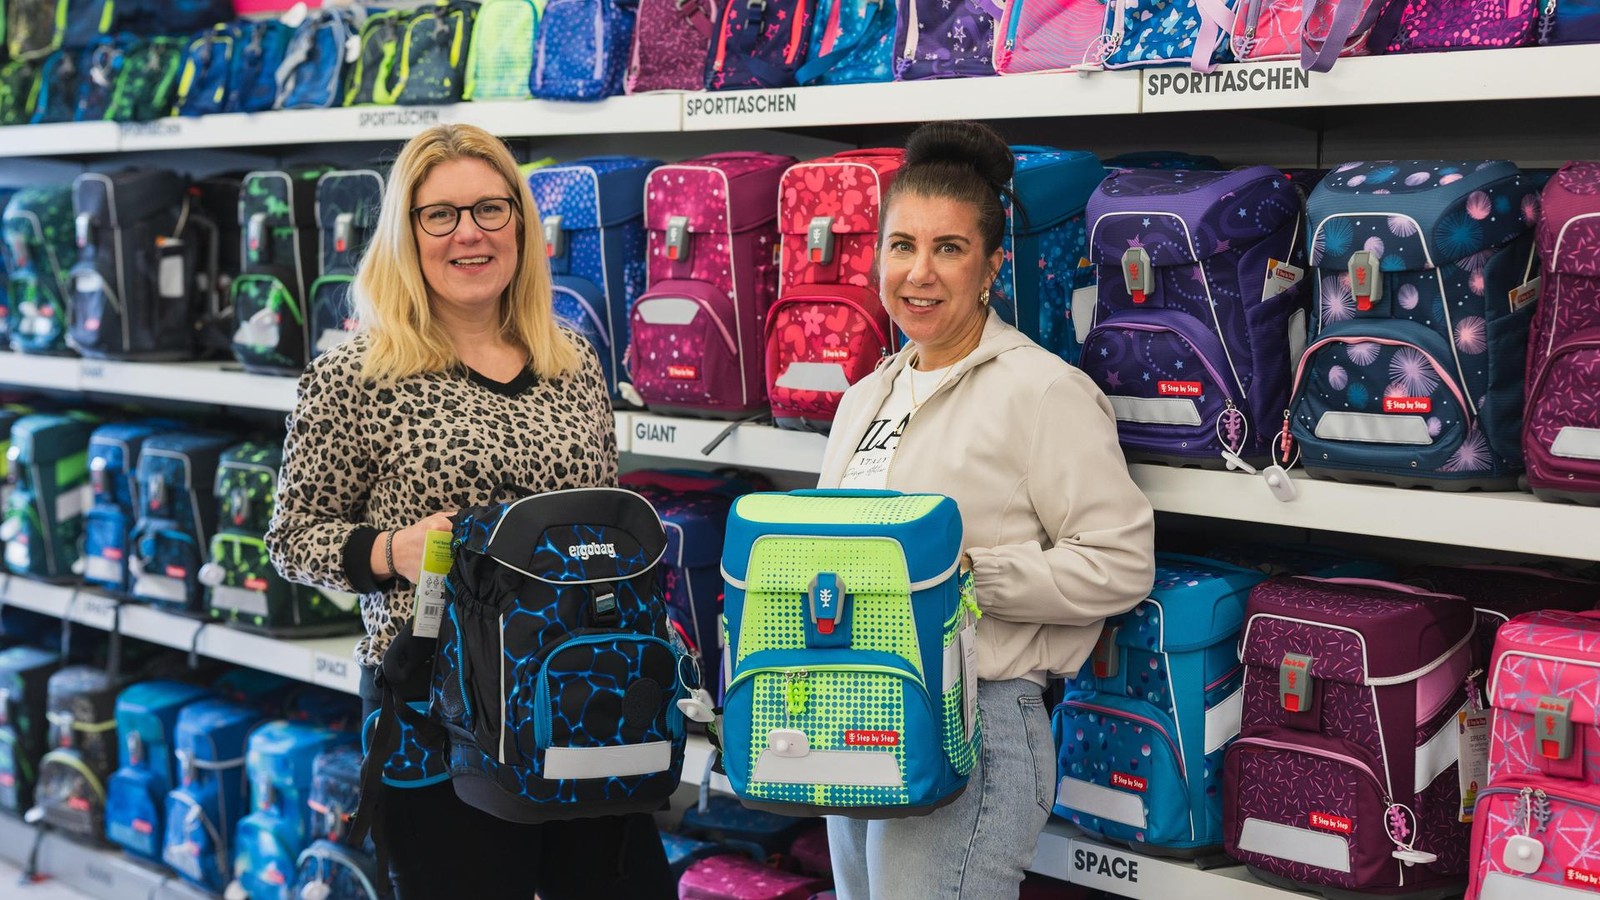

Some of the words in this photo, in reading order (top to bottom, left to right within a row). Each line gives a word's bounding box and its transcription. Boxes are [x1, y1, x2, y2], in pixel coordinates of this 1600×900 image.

[1148, 67, 1309, 96] SPORTTASCHEN
[687, 94, 796, 116] SPORTTASCHEN
[1167, 384, 1179, 393] Step
[1180, 385, 1187, 393] by
[1187, 385, 1199, 393] Step
[1393, 400, 1406, 410] Step
[1406, 400, 1414, 410] by
[1414, 400, 1428, 410] Step
[635, 422, 677, 443] GIANT
[568, 542, 617, 561] ergobag
[856, 733, 870, 743] Step
[871, 733, 880, 743] by
[880, 733, 895, 744] Step
[1118, 775, 1128, 786] Step
[1133, 779, 1144, 789] Step
[1318, 816, 1330, 827] Step
[1329, 818, 1337, 828] by
[1336, 820, 1349, 830] Step
[1074, 848, 1138, 883] SPACE
[1575, 871, 1589, 883] Step
[1589, 873, 1598, 885] by
